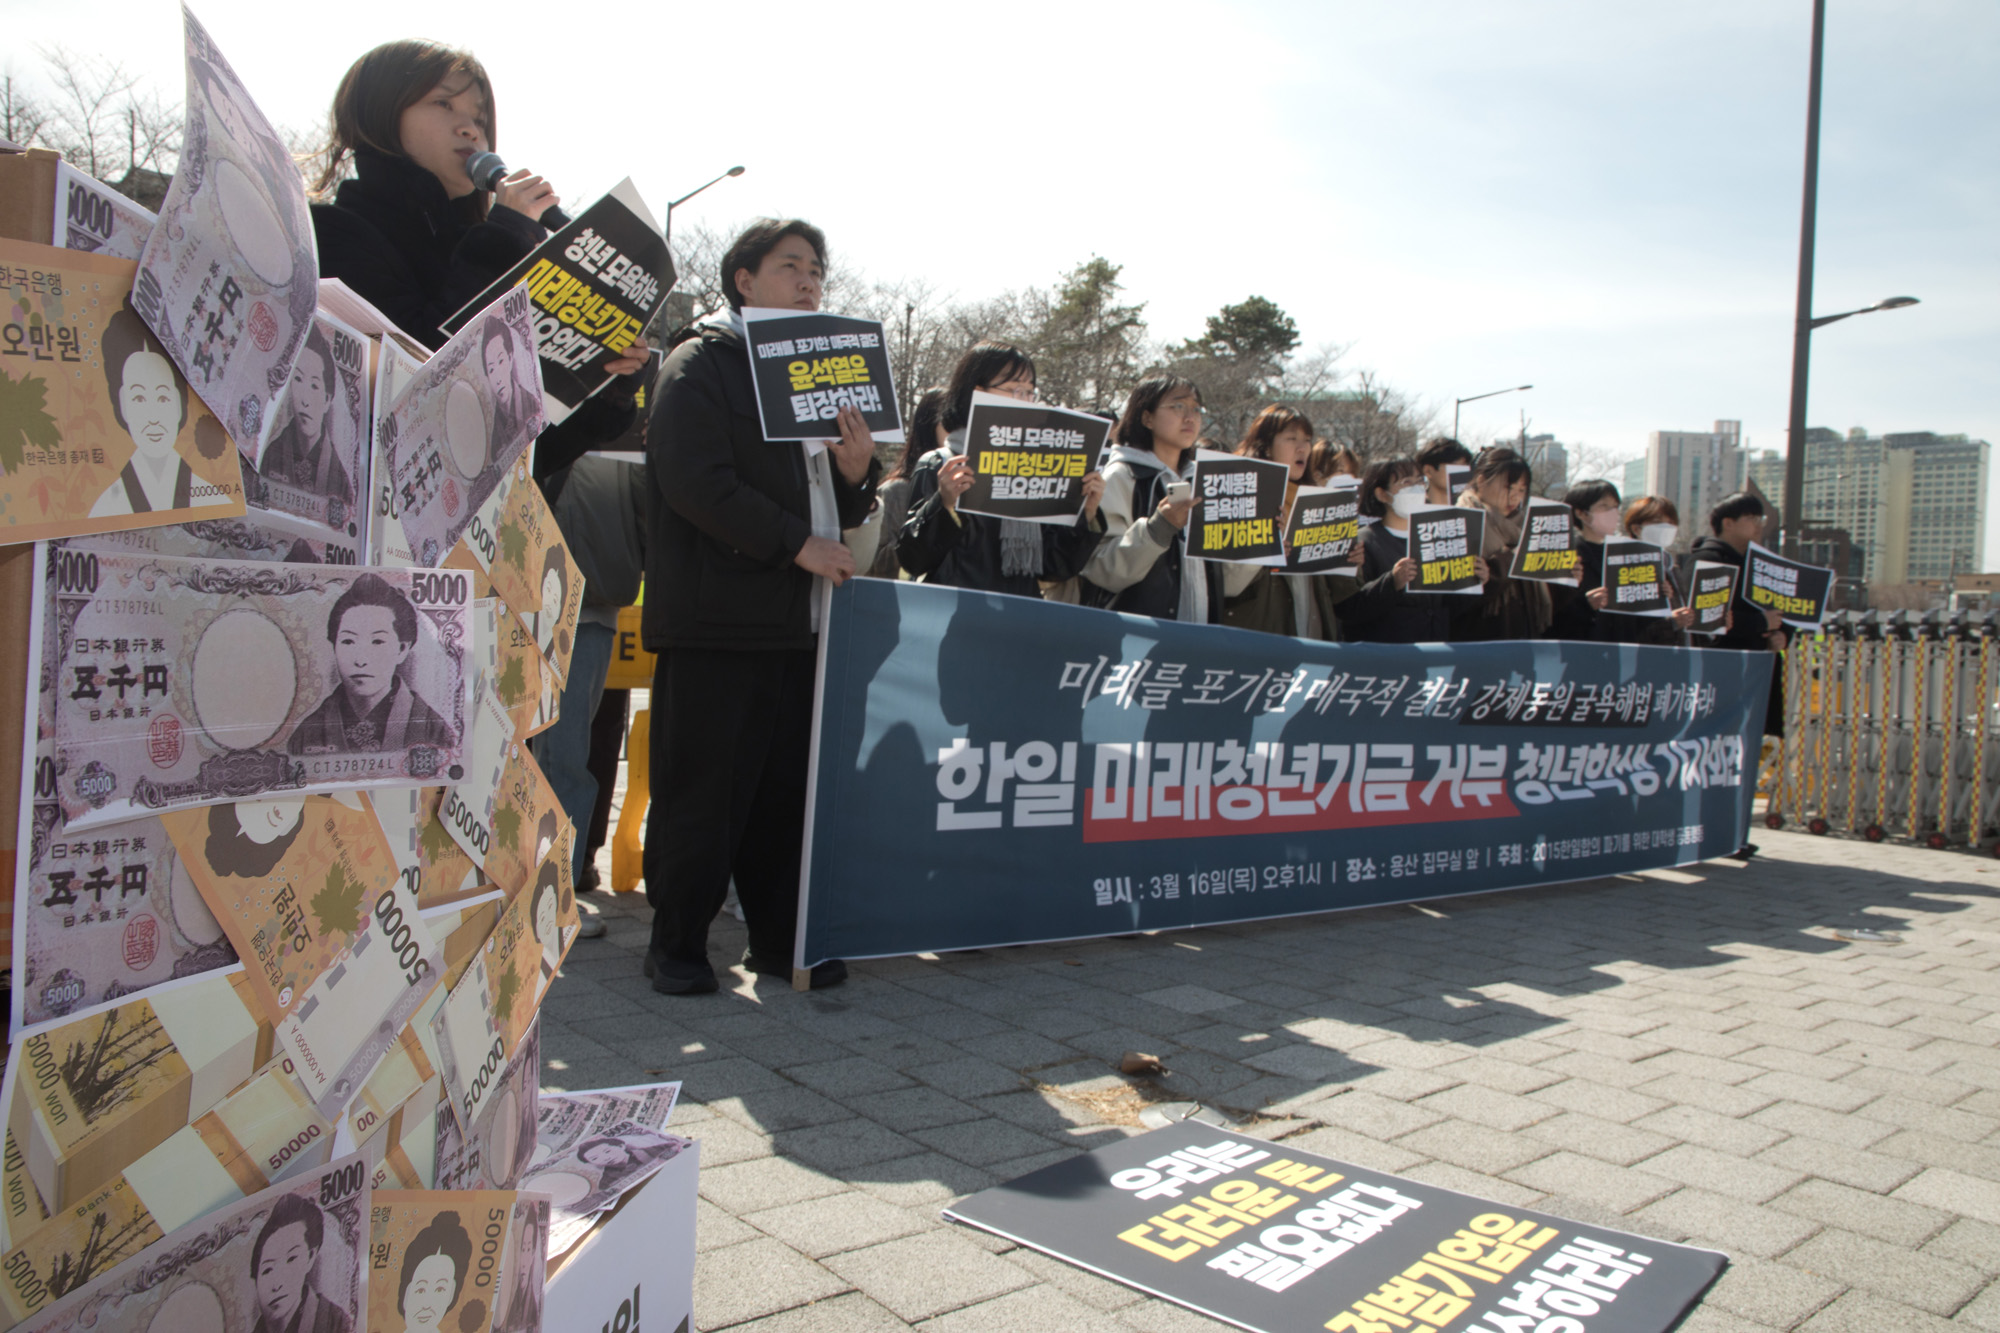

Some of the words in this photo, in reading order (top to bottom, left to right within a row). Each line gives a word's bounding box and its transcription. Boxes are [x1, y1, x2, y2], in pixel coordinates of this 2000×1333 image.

[67, 180, 114, 240] 000
[564, 227, 617, 275] 청년
[597, 253, 660, 312] 모욕하는
[504, 288, 527, 323] 5000
[2, 322, 82, 363] 오만원
[333, 329, 363, 373] 5000
[788, 354, 870, 391] 윤석열은
[790, 385, 883, 422] 퇴장하라!
[989, 425, 1022, 446] 청년
[1023, 428, 1085, 449] 모욕하는
[978, 451, 1087, 477] 미래청년기금
[991, 476, 1071, 500] 필요없다!
[1203, 472, 1258, 497] 강제동원
[1204, 496, 1257, 521] 굴욕해법
[1302, 508, 1325, 526] 청년
[1203, 518, 1274, 550] 폐기하라!
[1417, 517, 1467, 542] 강제동원
[1298, 539, 1353, 563] 필요없다!
[411, 572, 467, 606] 5000
[1752, 586, 1815, 616] 폐기하라!
[75, 638, 166, 653] 日本銀行券
[619, 632, 635, 660] E
[70, 664, 168, 700] 五千円
[1058, 656, 1187, 710] 미래를
[1182, 667, 1308, 713] 포기한
[1304, 672, 1409, 717] 매국적
[1471, 679, 1573, 722] 강제동원
[1571, 683, 1653, 723] 굴욕해법
[1653, 682, 1717, 721] 폐기하라!
[89, 706, 152, 722] 日本銀行
[81, 777, 112, 796] 5000
[936, 738, 1078, 831] 한일
[1091, 739, 1414, 822] 미래청년기금
[1419, 744, 1508, 808] 거부
[446, 791, 491, 856] 50000
[52, 837, 147, 859] 日本銀行券
[43, 863, 149, 908] 五千円
[1150, 873, 1180, 899] 3월
[1188, 866, 1256, 895] 16일(목)
[1390, 852, 1419, 878] 용산
[1422, 850, 1462, 875] 집무실
[1465, 848, 1480, 870] 앞
[63, 908, 129, 928] 日本銀行
[272, 882, 314, 953] 오만원
[374, 889, 430, 987] 50000
[47, 983, 80, 1005] 5000
[26, 1031, 62, 1091] 50000
[44, 1089, 69, 1127] won
[463, 1036, 506, 1121] 50000
[268, 1124, 321, 1170] 50000
[319, 1160, 365, 1206] 5000
[1110, 1140, 1272, 1201] 우리는
[8, 1173, 28, 1218] won
[76, 1190, 112, 1217] Bank
[114, 1178, 128, 1192] of
[1116, 1179, 1301, 1263] 더러운
[1254, 1158, 1346, 1194] 돈
[474, 1207, 505, 1288] 50000
[1205, 1181, 1424, 1293] 필요없다
[4, 1250, 49, 1309] 50000
[1464, 1236, 1654, 1333] 상하라!
